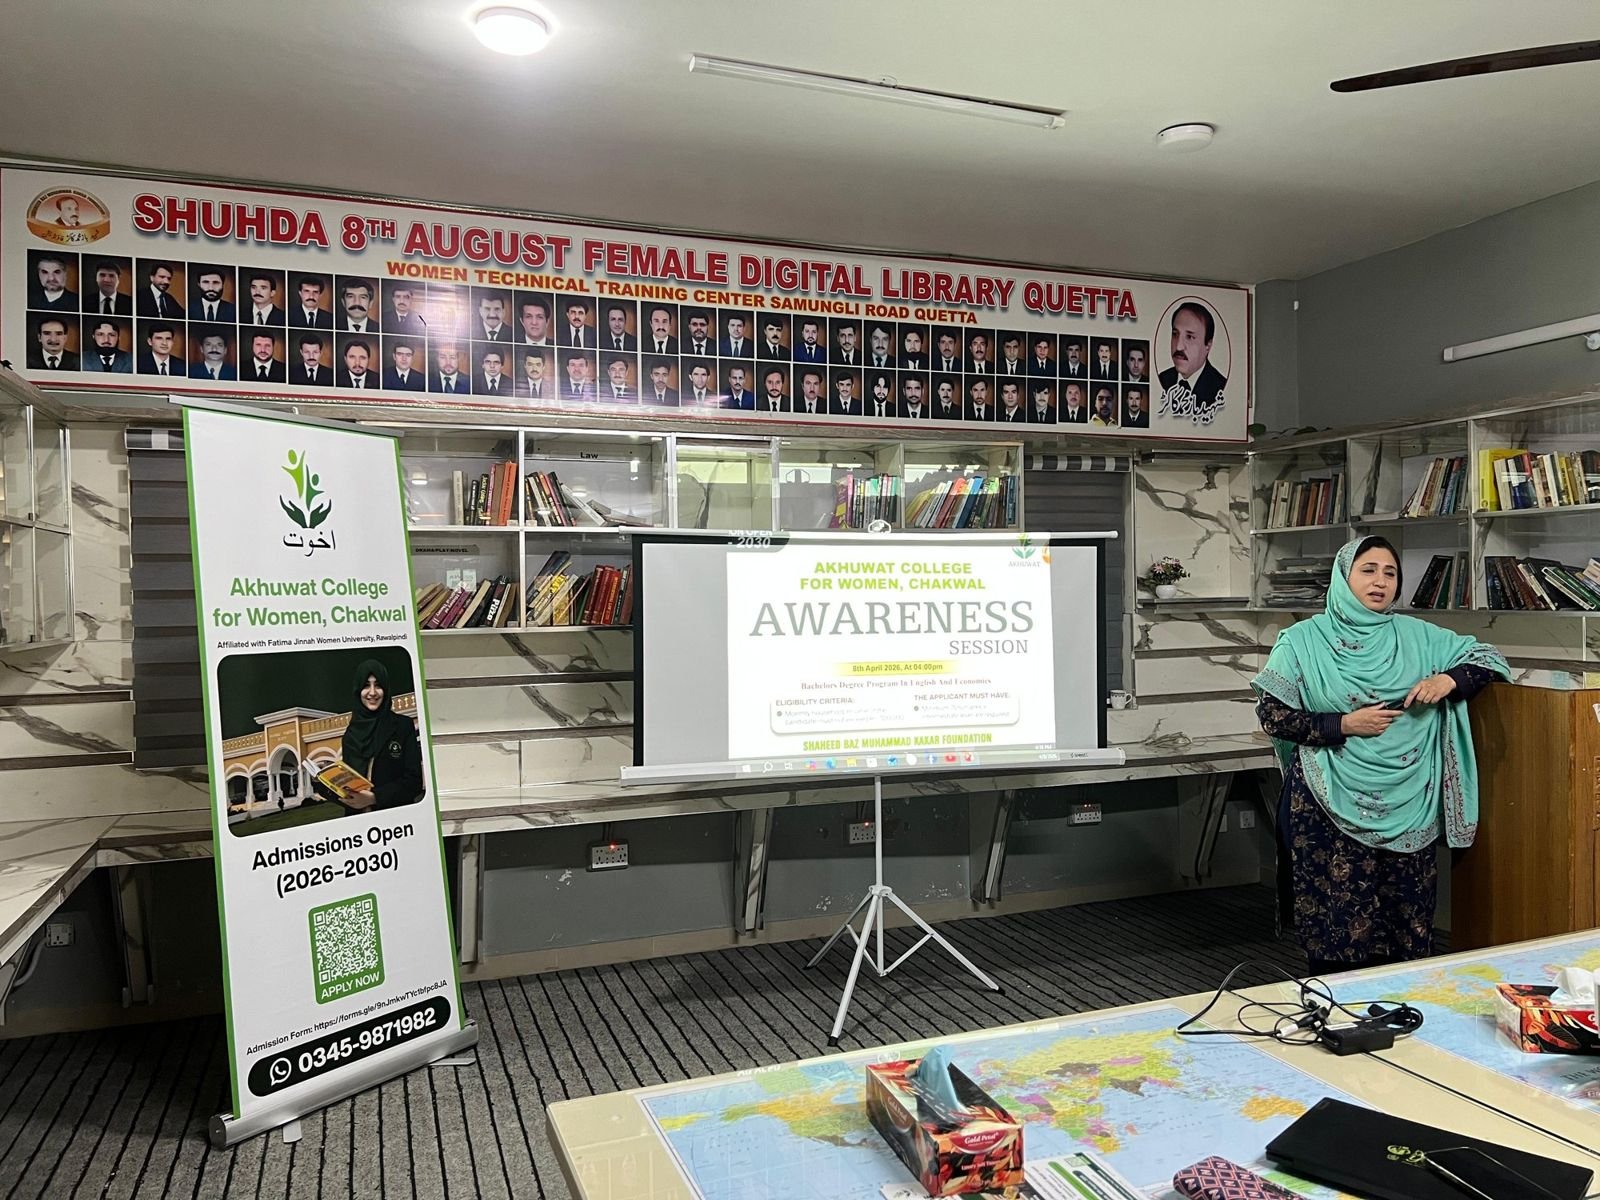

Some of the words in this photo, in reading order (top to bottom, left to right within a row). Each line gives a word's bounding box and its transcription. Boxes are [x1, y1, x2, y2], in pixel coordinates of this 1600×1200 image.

[133, 194, 329, 247] SHUHDA
[341, 214, 397, 250] 8TH
[402, 222, 571, 269] AUGUST
[583, 239, 728, 284] FEMALE
[739, 254, 872, 297] DIGITAL
[881, 267, 1015, 308] LIBRARY
[1023, 280, 1137, 318] QUETTA
[387, 261, 468, 282] WOMEN
[475, 269, 589, 292] TECHNICAL
[596, 280, 687, 300] TRAINING
[694, 290, 764, 308] CENTER
[771, 296, 859, 315] SAMUNGLI
[866, 304, 909, 319] ROAD
[915, 308, 977, 324] QUETTA
[580, 451, 599, 459] Law
[283, 530, 336, 557] اخوت
[736, 537, 770, 549] 2030
[814, 562, 895, 574] AKHUWAT
[901, 563, 972, 574] COLLEGE
[230, 577, 317, 597] Akhuwat
[321, 578, 389, 599] College
[800, 578, 833, 590] FOR
[838, 578, 904, 591] WOMEN,
[909, 578, 986, 590] CHAKWAL
[213, 607, 241, 627] for
[246, 606, 327, 627] Women,
[330, 605, 407, 623] Chakwal
[749, 600, 1034, 637] AWARENESS
[217, 641, 249, 649] Affiliated
[293, 637, 315, 645] Jinnah
[316, 636, 341, 644] Women
[342, 635, 375, 643] University,
[376, 633, 407, 641] Rawalpindi
[949, 639, 1028, 655] SESSION
[865, 664, 883, 673] April
[801, 682, 837, 690] Bachelors
[866, 680, 898, 688] Program
[929, 693, 968, 701] APPLICANT
[803, 740, 841, 752] SHAHEED
[843, 739, 859, 749] BAZ
[861, 736, 912, 748] MUHAMMAD
[942, 733, 993, 745] FOUNDATION
[251, 835, 363, 871] Admissions
[366, 823, 414, 847] Open
[320, 980, 353, 1000] APPLY
[355, 971, 380, 988] NOW
[246, 1033, 289, 1056] Admission
[290, 1025, 313, 1041] Form:
[298, 1006, 437, 1073] 0345-9871982
[964, 1134, 981, 1145] Gold
